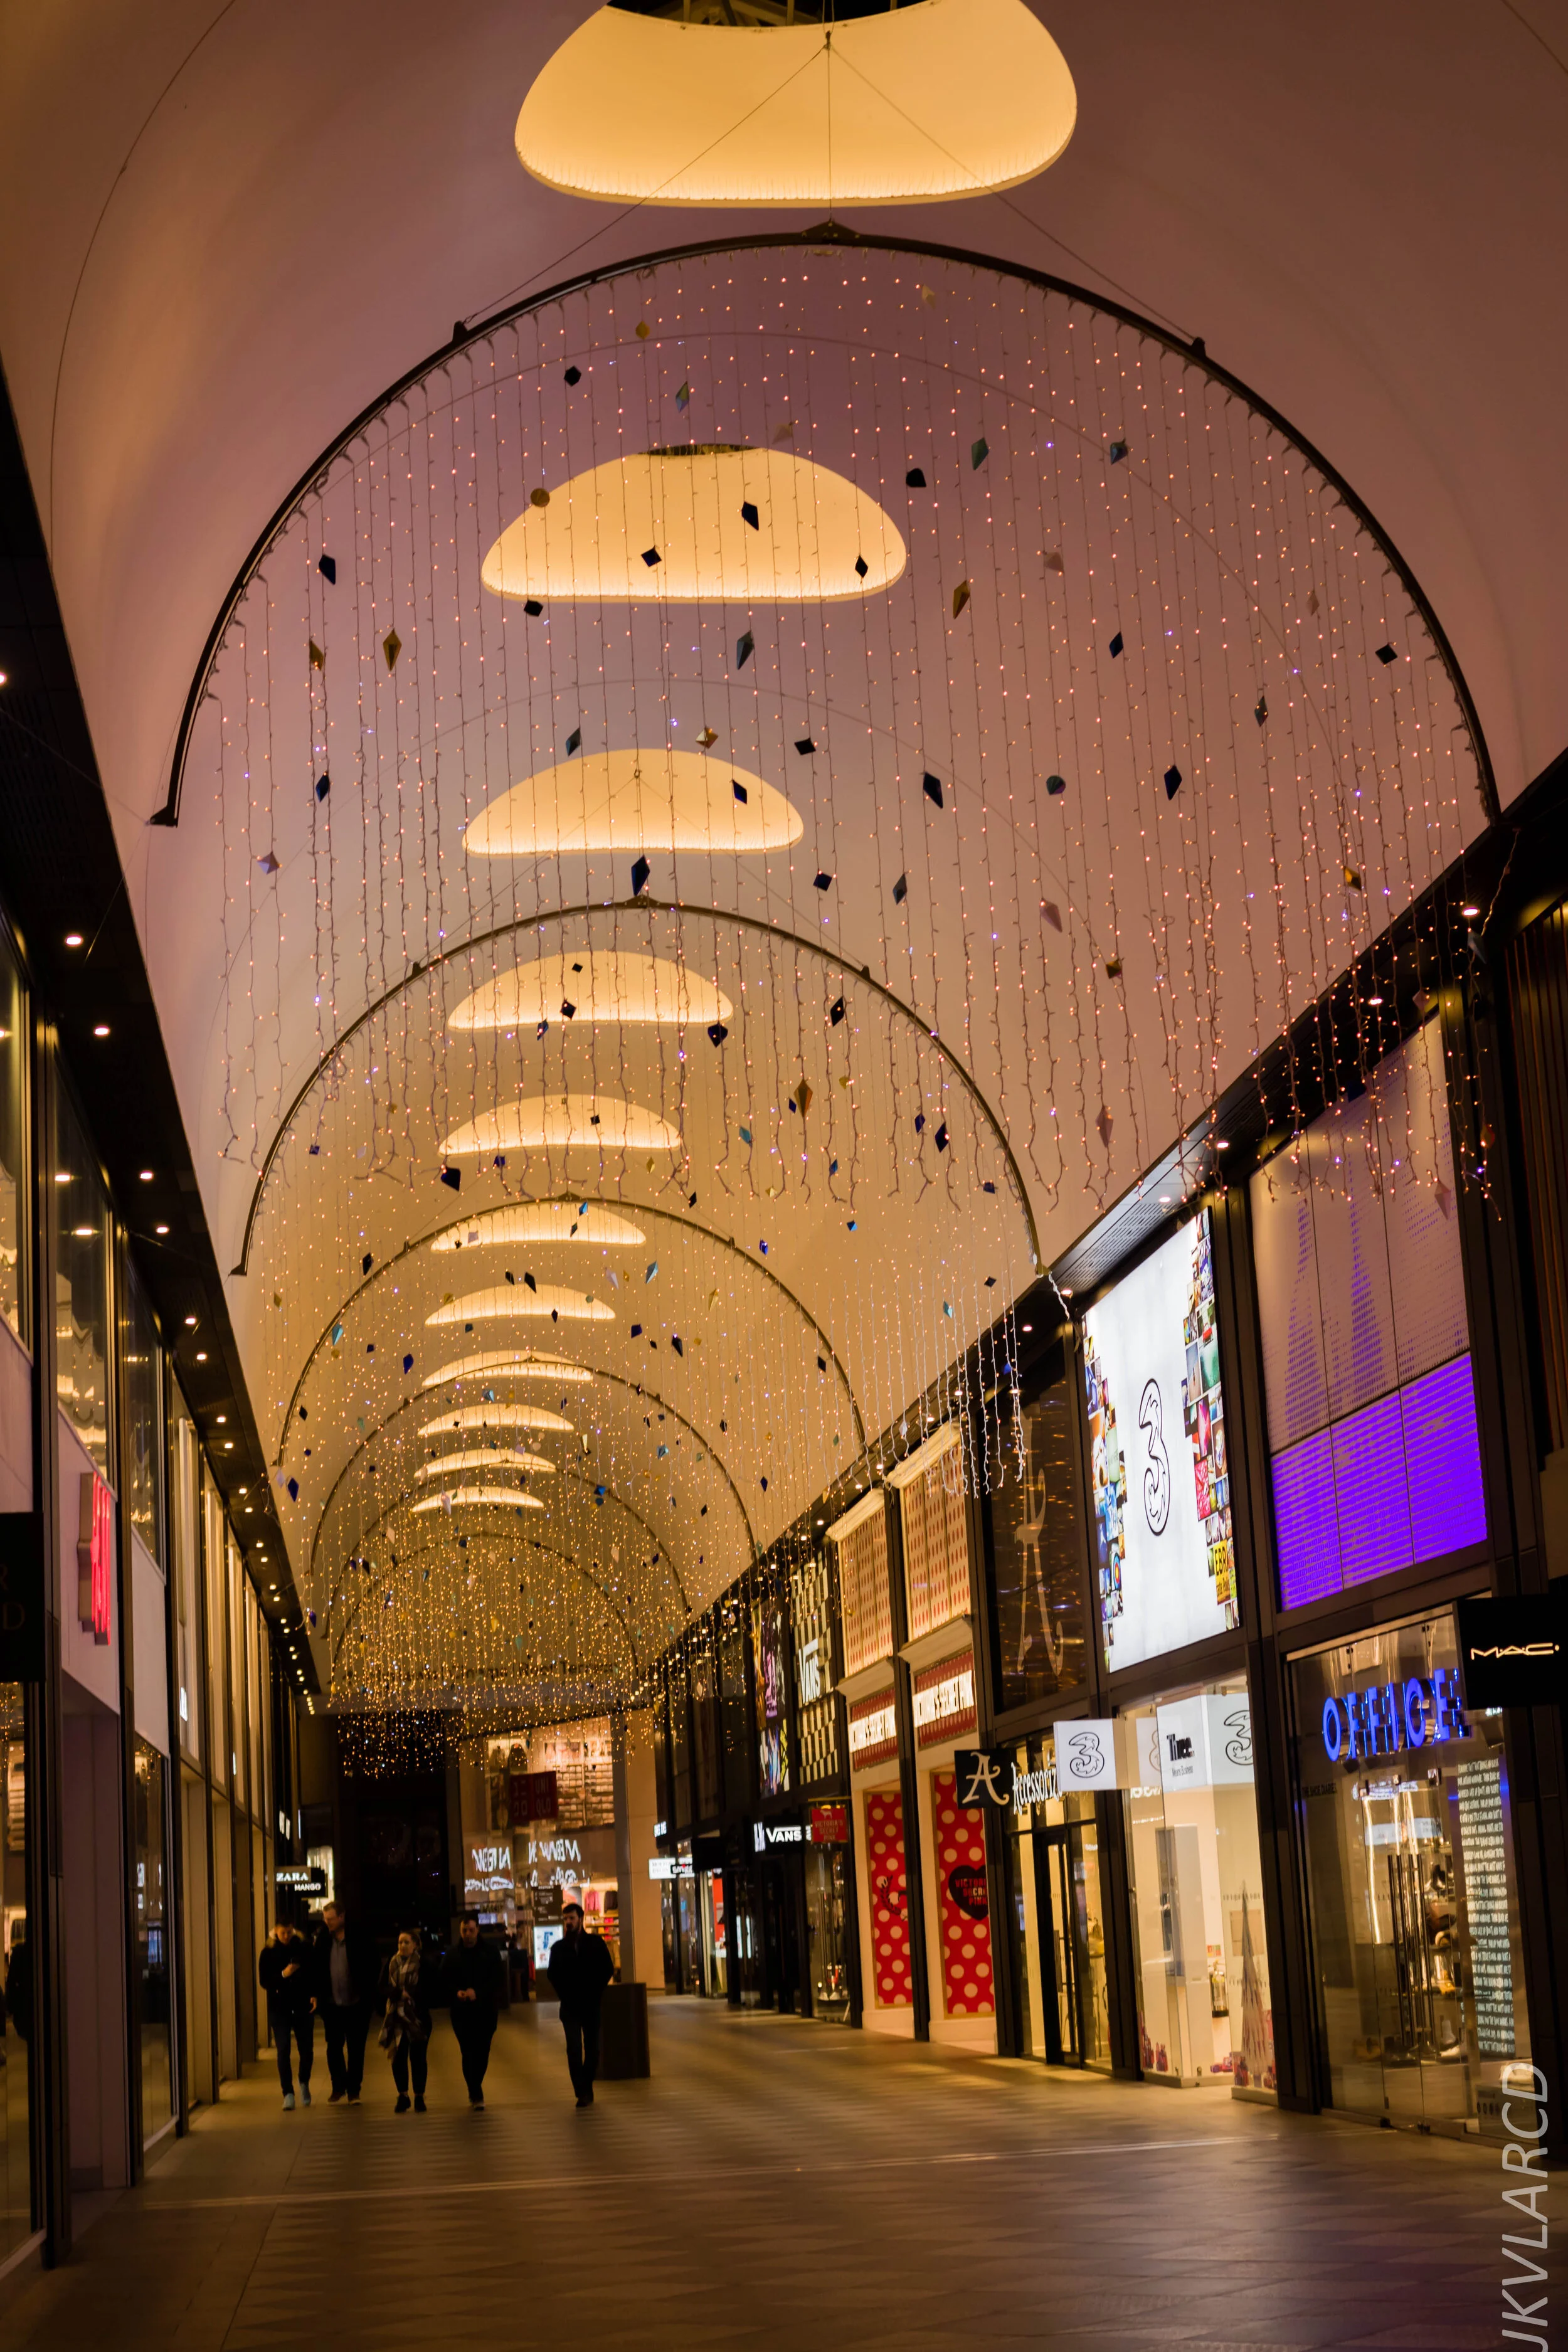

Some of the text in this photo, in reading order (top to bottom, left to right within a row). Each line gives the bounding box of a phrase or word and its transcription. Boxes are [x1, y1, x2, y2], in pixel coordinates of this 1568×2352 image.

[798, 1638, 821, 1705] VANS
[1322, 1668, 1458, 1762] OFFICE
[962, 1751, 1009, 1806] A
[1067, 1731, 1105, 1779] 3
[1010, 1762, 1064, 1816] Accessoriz
[765, 1825, 803, 1843] VANS
[276, 1872, 309, 1882] ZARA
[294, 1882, 322, 1892] MANGO
